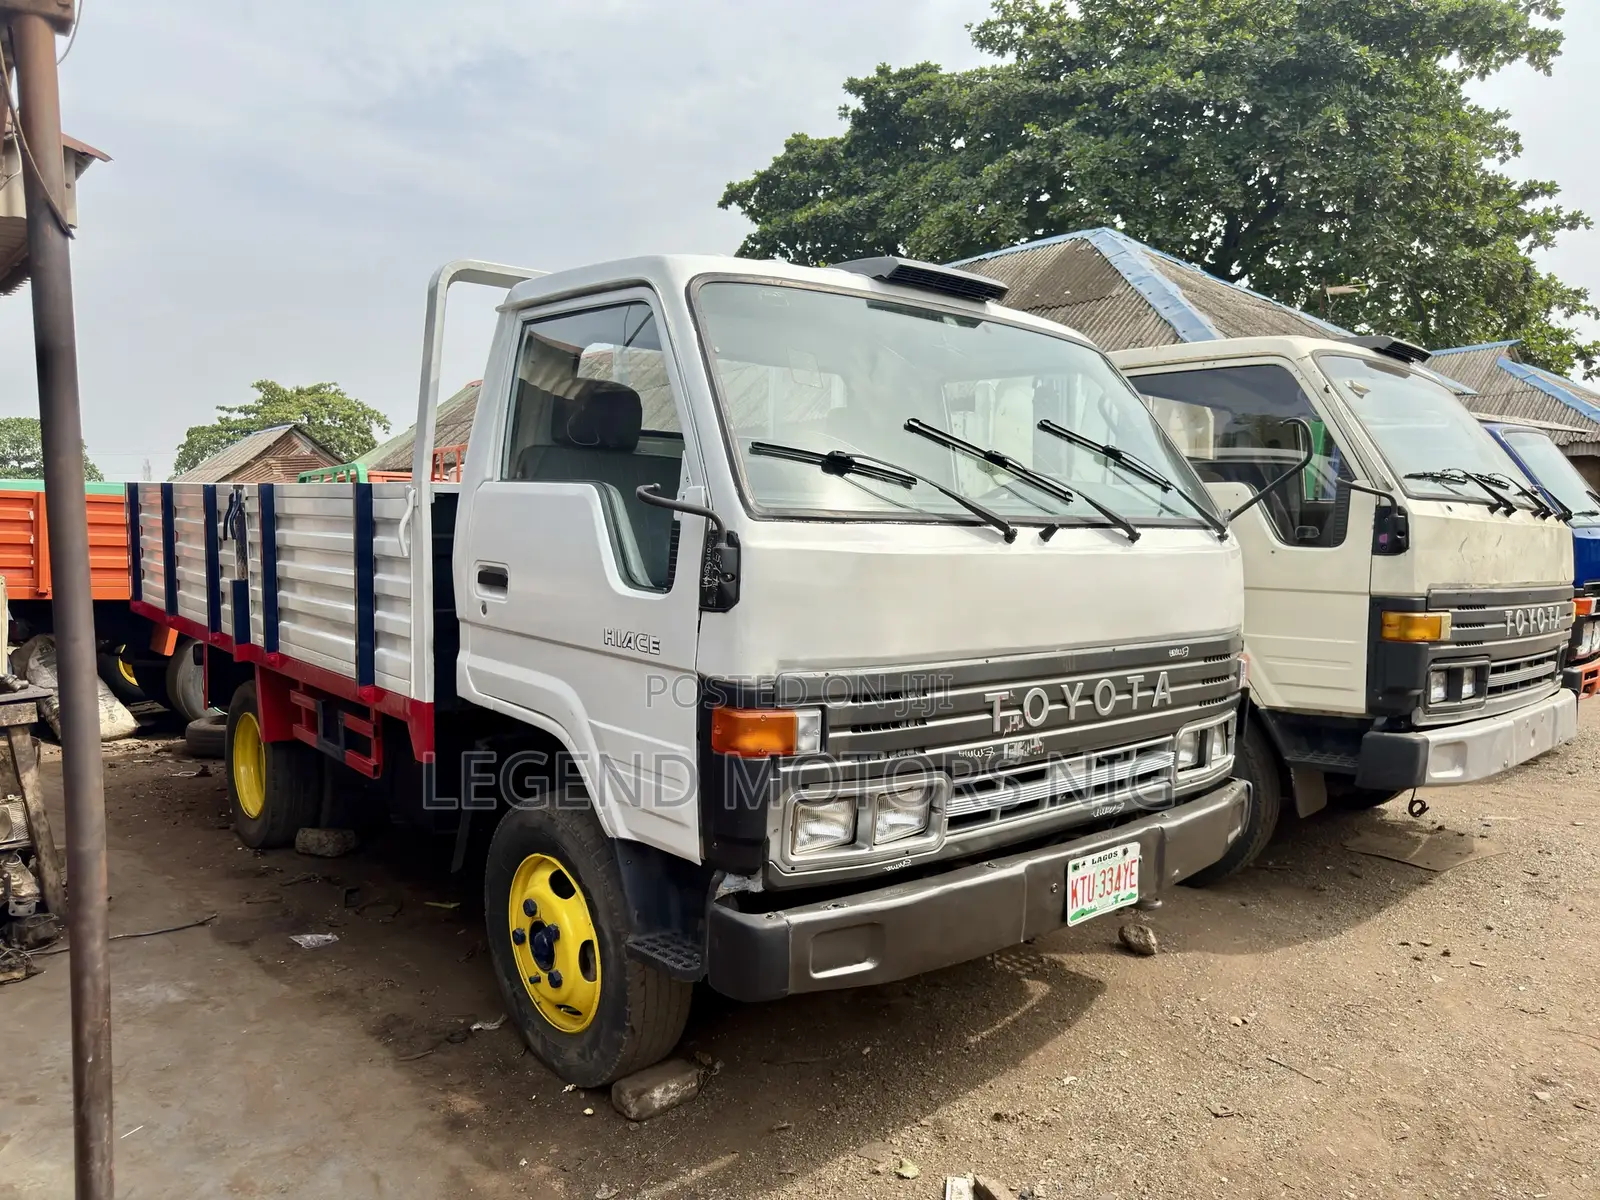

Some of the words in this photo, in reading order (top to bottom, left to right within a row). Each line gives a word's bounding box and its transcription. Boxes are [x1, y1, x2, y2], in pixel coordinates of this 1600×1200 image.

[1504, 605, 1560, 637] TOYOTA
[603, 627, 661, 655] HIACE
[984, 671, 1173, 733] TOYOTA
[1091, 850, 1119, 865] LAGOS
